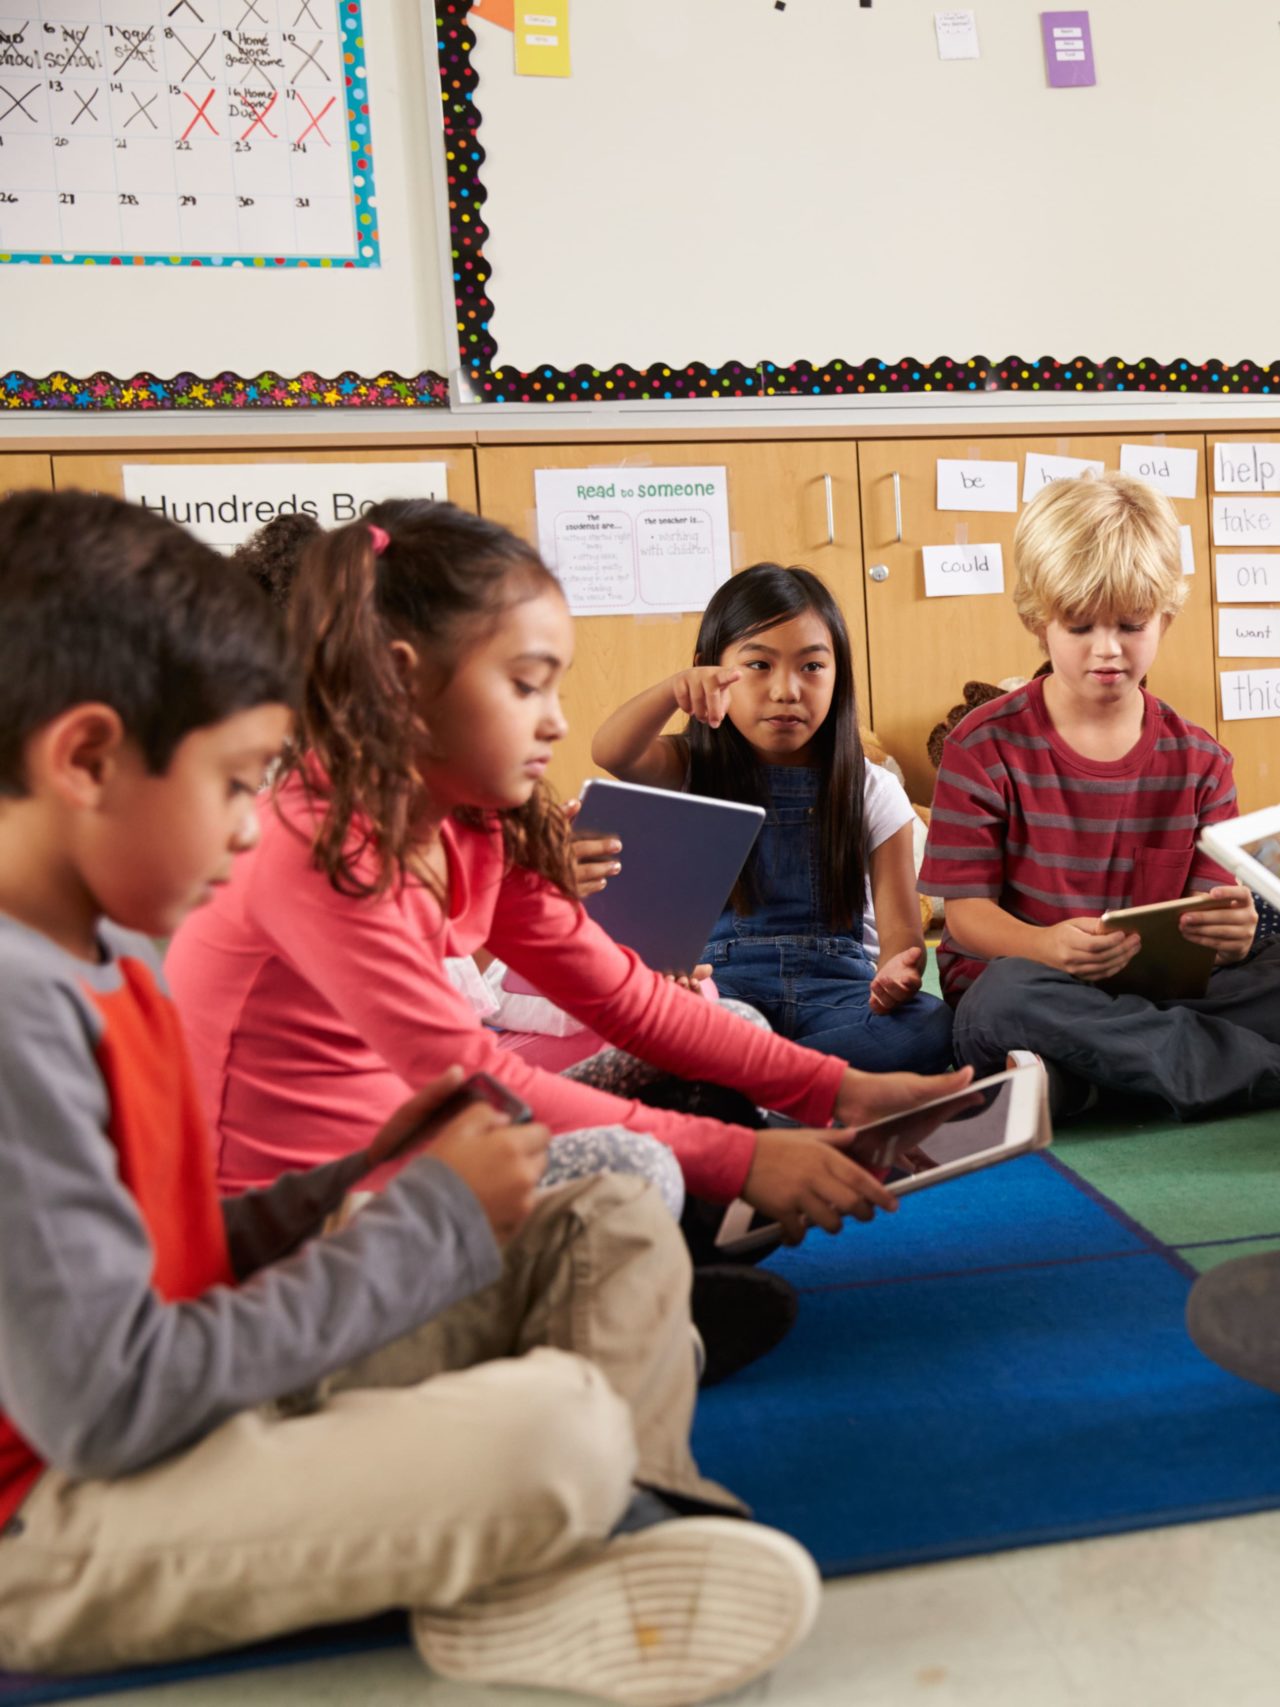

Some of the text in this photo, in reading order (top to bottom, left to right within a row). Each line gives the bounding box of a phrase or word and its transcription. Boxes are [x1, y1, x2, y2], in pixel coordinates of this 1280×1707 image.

[282, 33, 296, 43] 10
[49, 80, 64, 92] 13
[110, 82, 124, 94] 14
[169, 85, 182, 96] 15
[286, 89, 296, 100] 17
[175, 140, 193, 151] 22
[234, 141, 252, 153] 23
[0, 192, 19, 204] 26
[180, 196, 199, 208] 29
[238, 196, 257, 208] 30
[295, 196, 312, 209] 31
[1139, 461, 1171, 478] old
[1220, 446, 1275, 490] help
[960, 471, 986, 489] be
[577, 482, 715, 500] Read to someone
[141, 493, 319, 524] Hundreds
[1220, 506, 1273, 533] take
[940, 555, 990, 574] could
[1237, 566, 1269, 587] on
[1235, 625, 1272, 639] want
